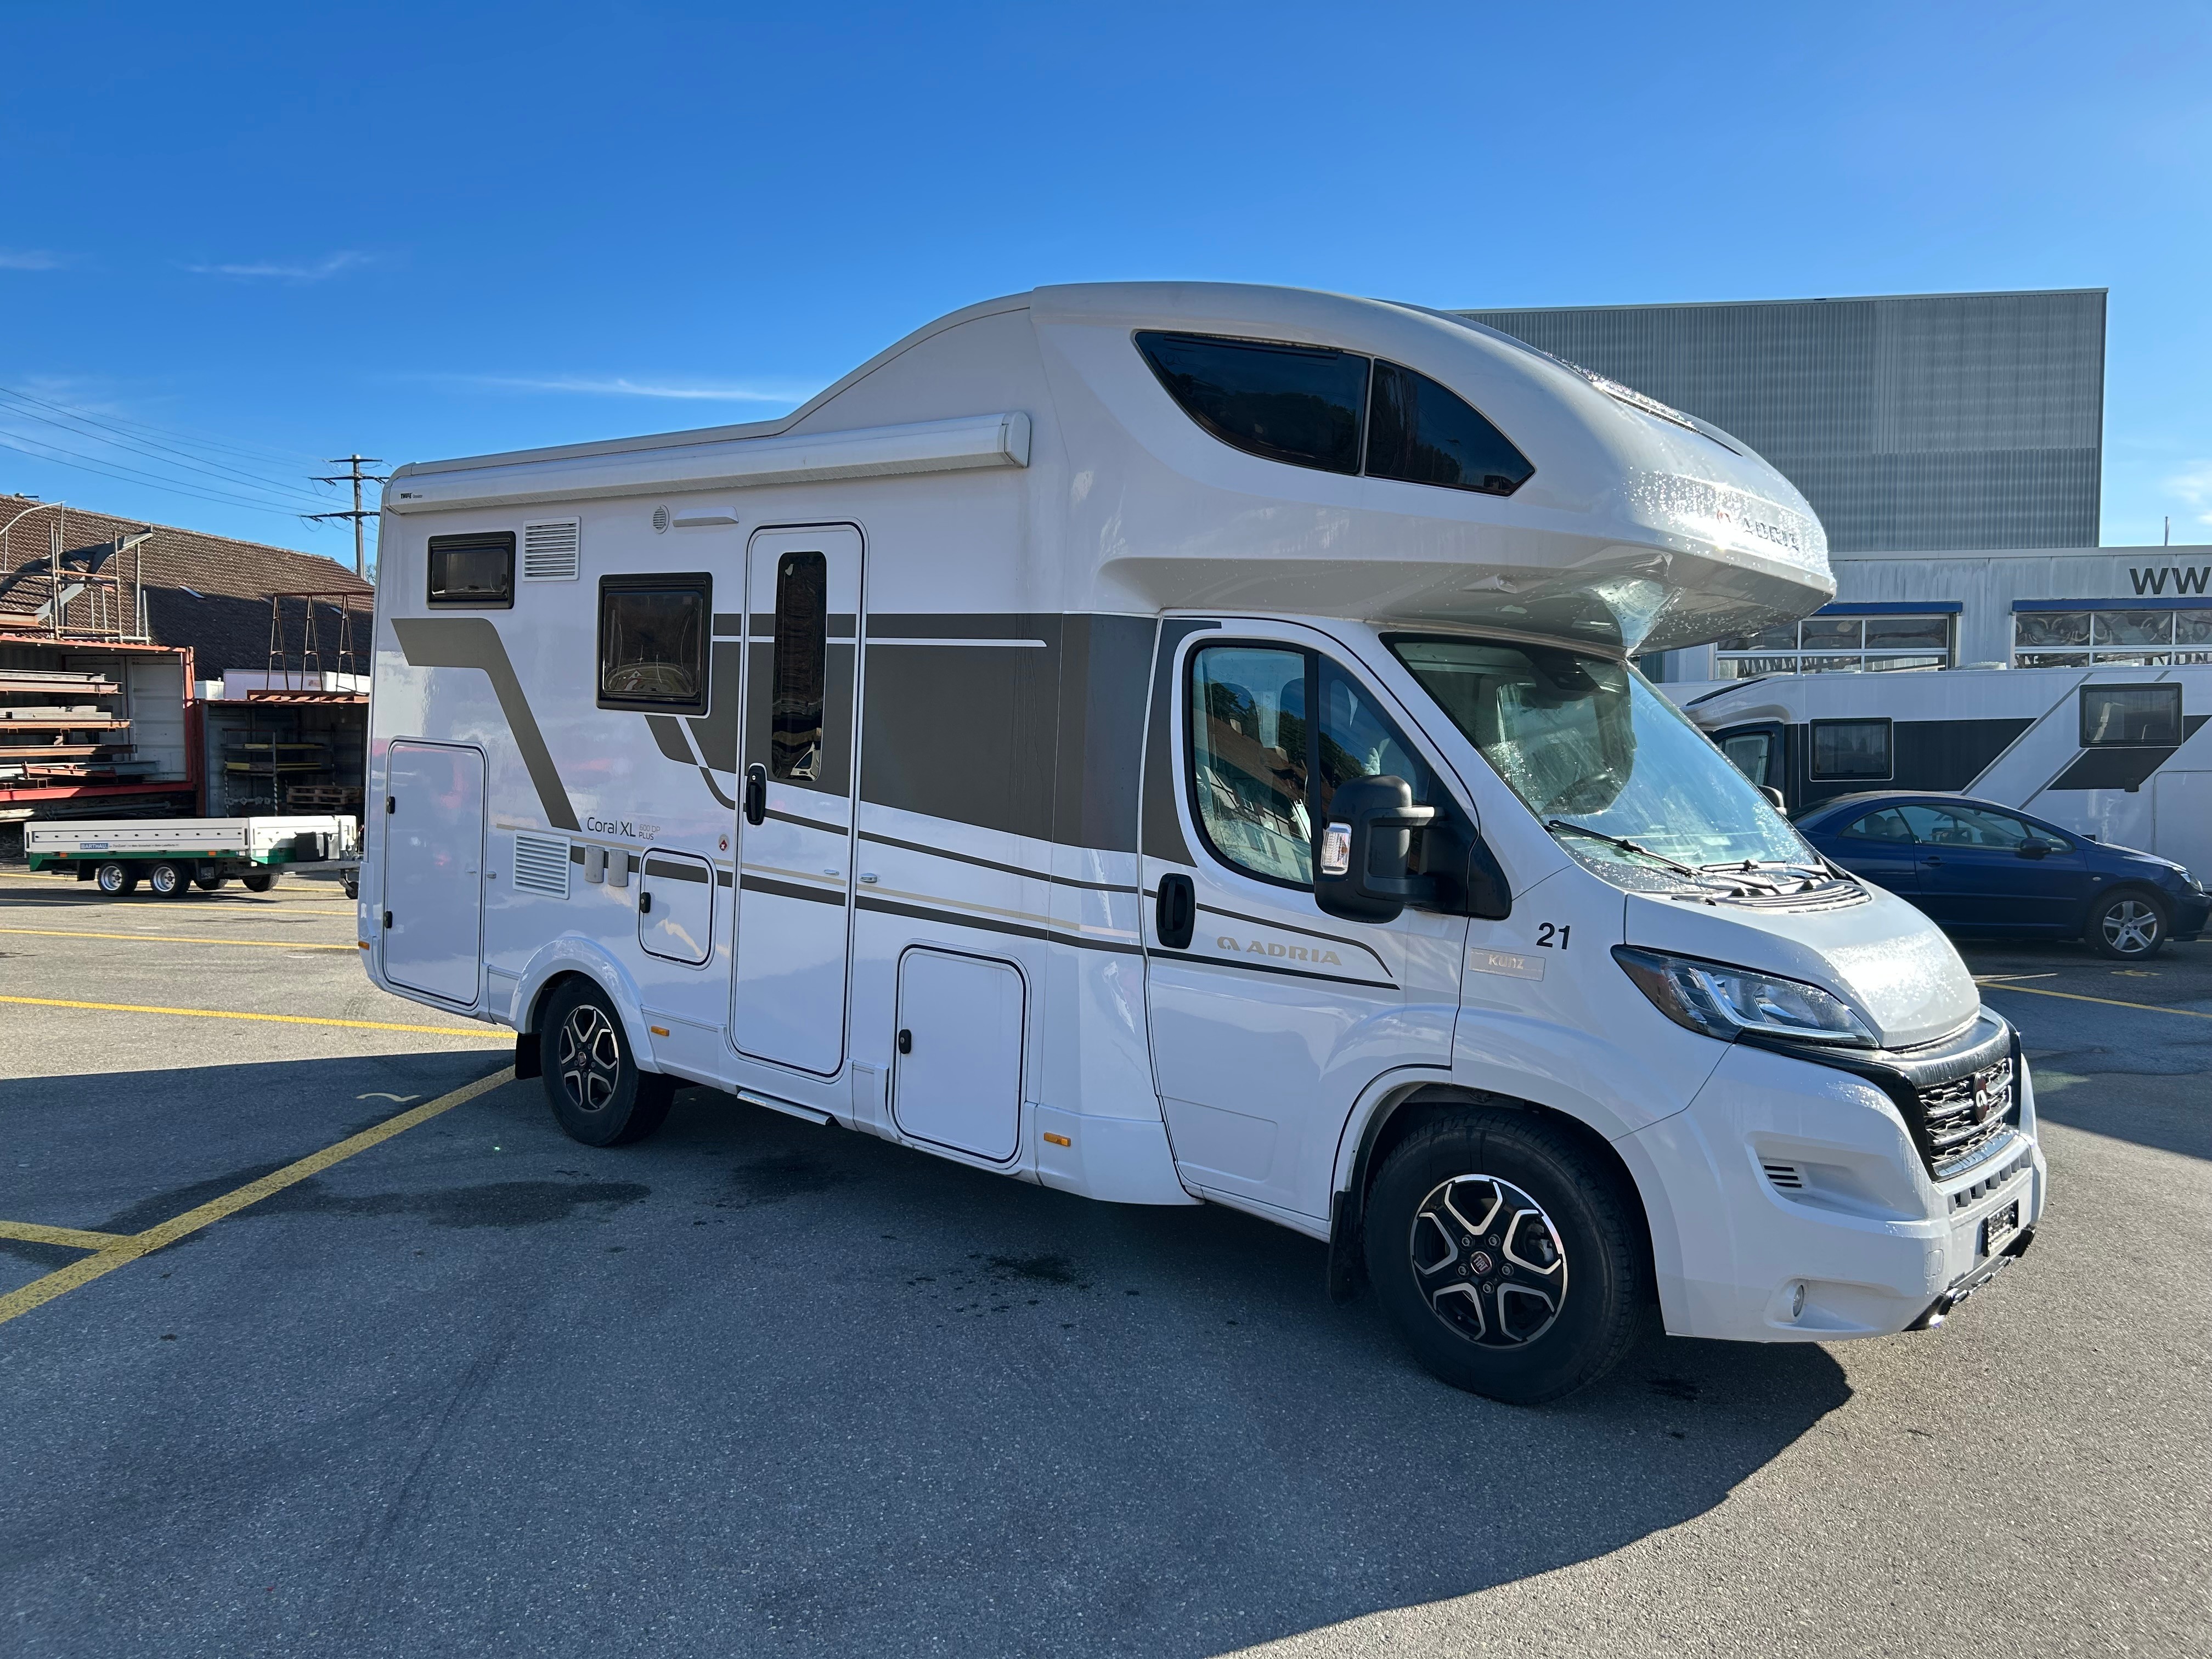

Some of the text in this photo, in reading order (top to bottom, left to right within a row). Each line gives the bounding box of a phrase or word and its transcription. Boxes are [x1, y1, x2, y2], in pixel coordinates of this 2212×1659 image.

[587, 817, 636, 837] Coral XL
[639, 823, 651, 832] 600
[639, 831, 654, 840] PLUS
[1536, 922, 1570, 950] 21
[1246, 940, 1342, 966] ADRIA
[1473, 1255, 1489, 1271] FIAT
